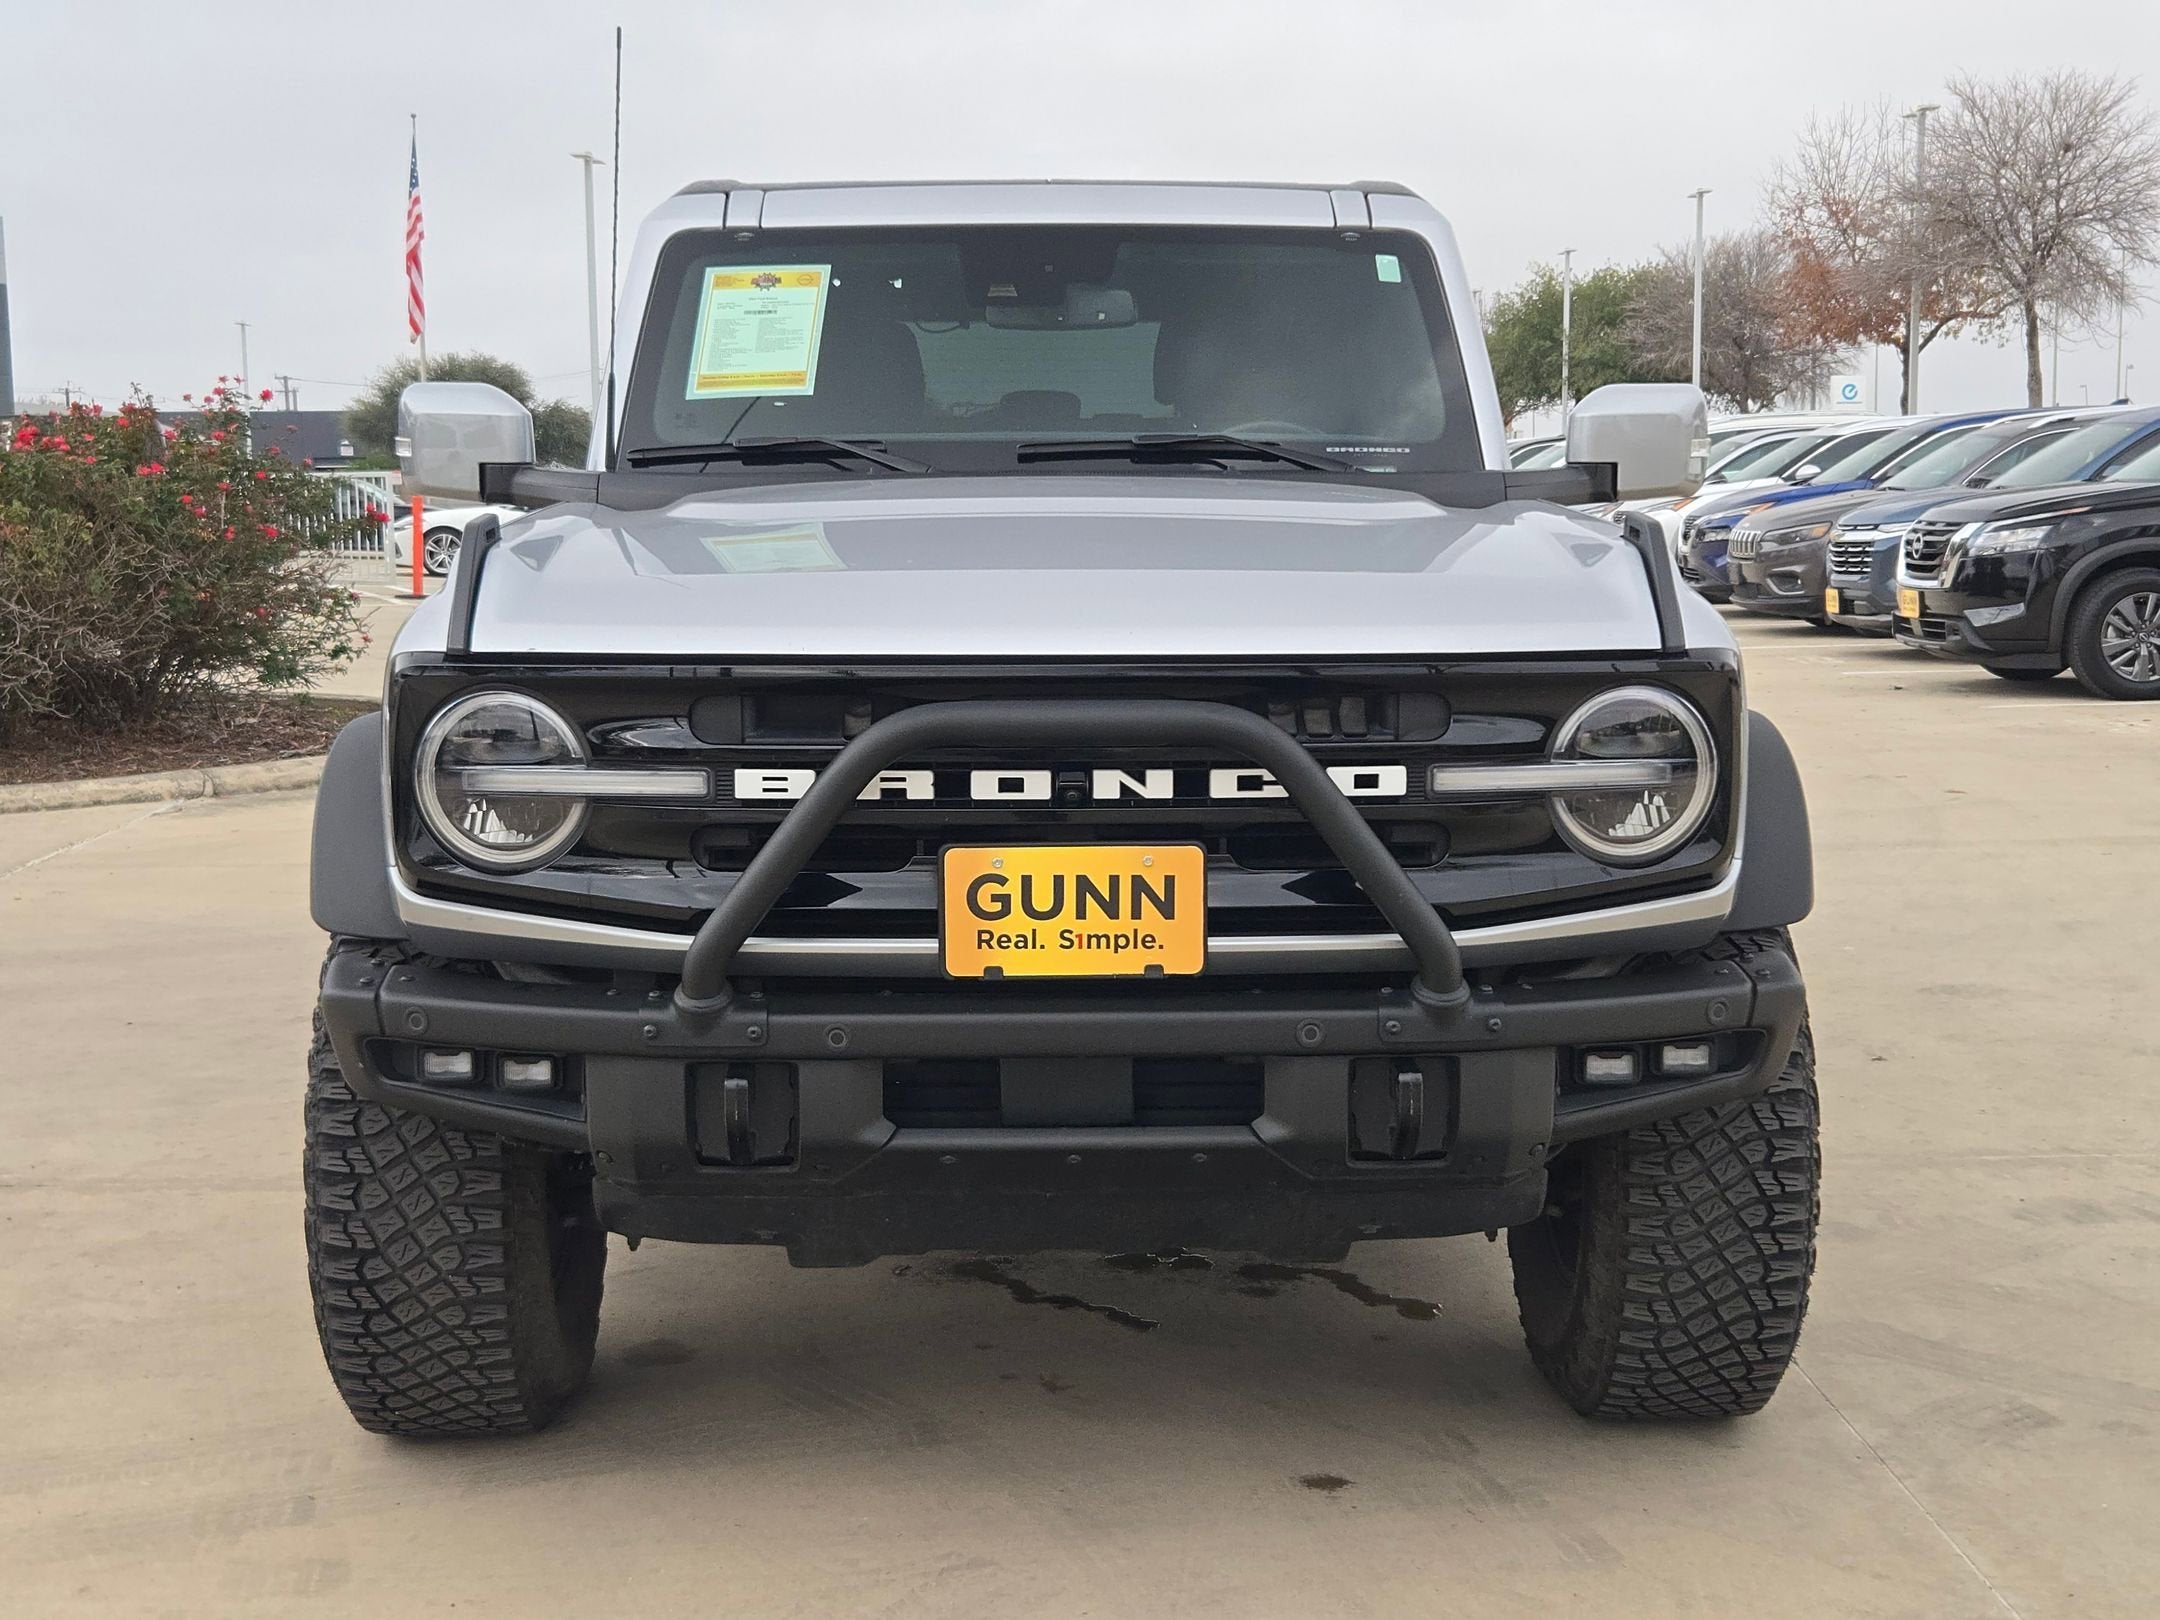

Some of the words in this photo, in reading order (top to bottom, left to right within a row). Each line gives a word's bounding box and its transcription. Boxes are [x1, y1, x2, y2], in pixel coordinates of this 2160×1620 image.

[734, 765, 1407, 799] BRONCO
[966, 873, 1176, 921] GUNN
[976, 928, 1045, 950] Real.
